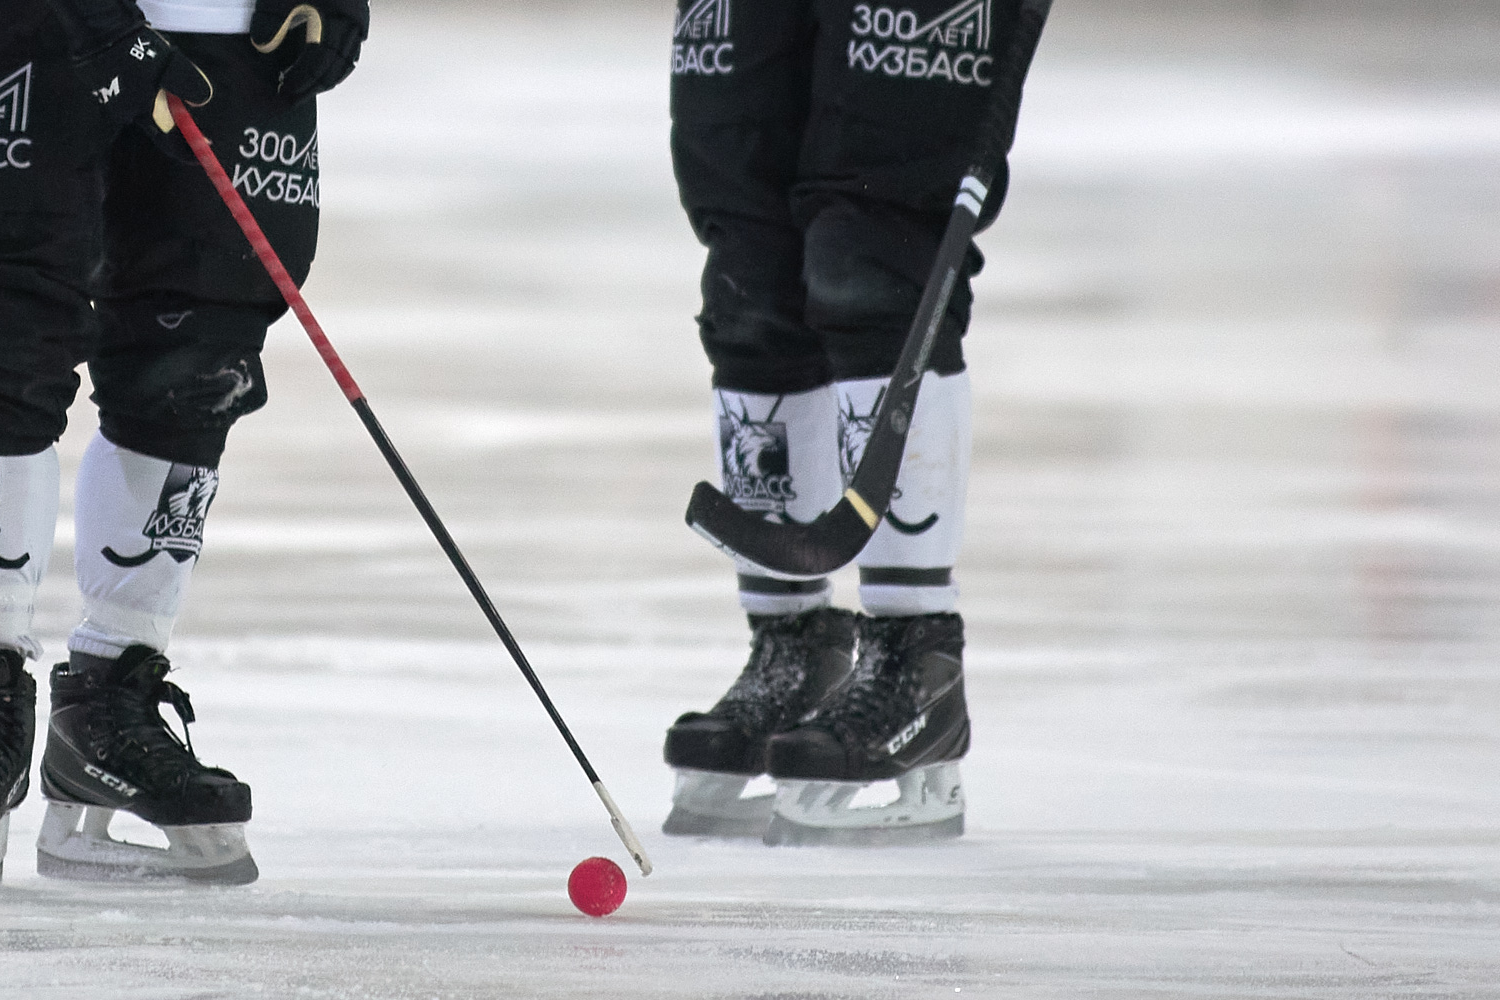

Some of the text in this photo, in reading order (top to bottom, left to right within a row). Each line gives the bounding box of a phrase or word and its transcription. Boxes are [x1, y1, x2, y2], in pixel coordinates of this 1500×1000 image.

[852, 4, 917, 40] 300
[848, 39, 994, 87] КУЗБАСС
[239, 127, 319, 170] 300 ЛЕ
[232, 164, 320, 209] КУЗБА
[143, 511, 204, 540] КУЗБА
[887, 713, 927, 755] CCM
[83, 763, 138, 797] CCM
